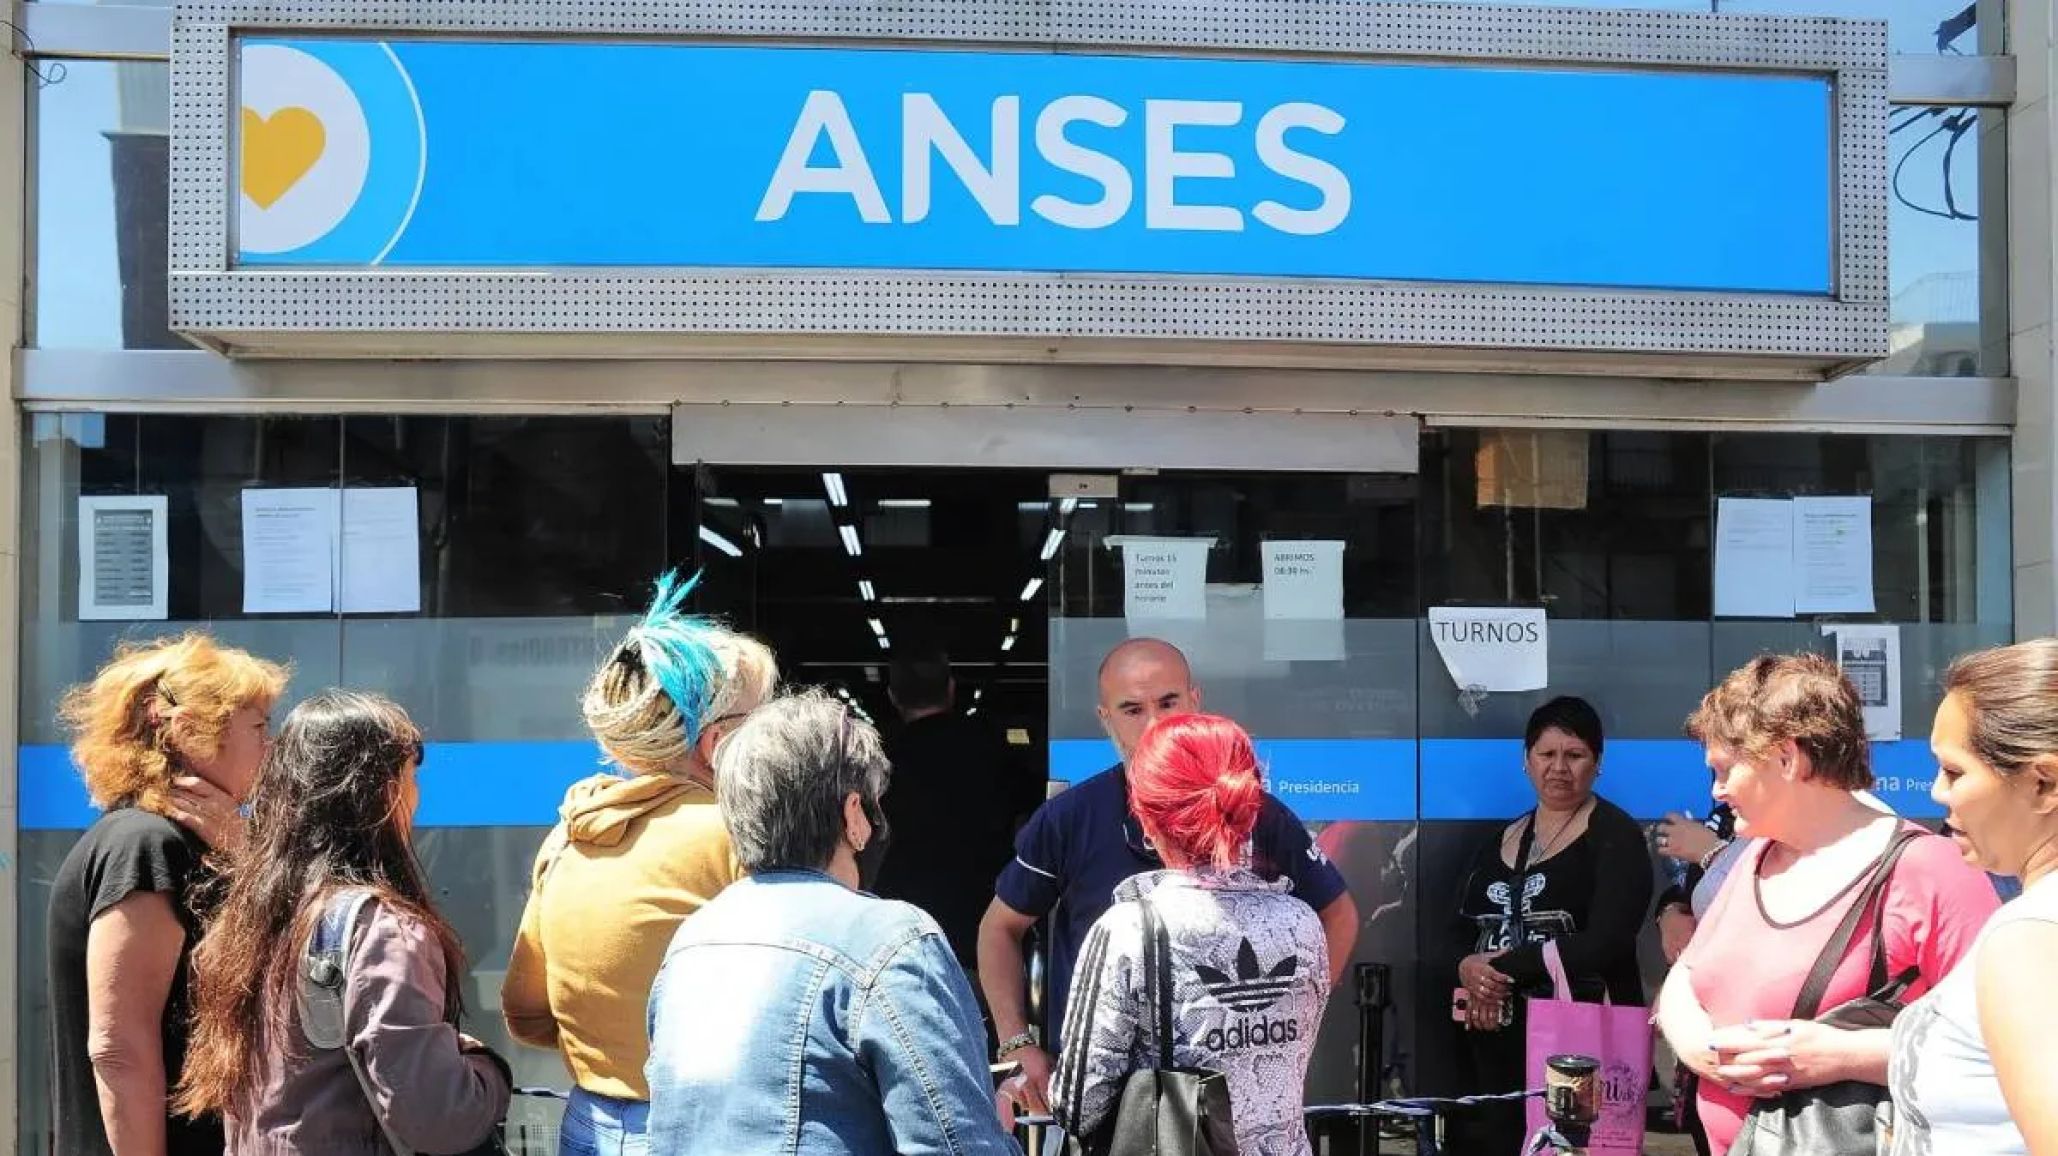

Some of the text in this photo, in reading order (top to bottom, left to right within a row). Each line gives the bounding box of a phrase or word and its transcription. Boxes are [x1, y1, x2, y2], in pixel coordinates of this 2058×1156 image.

[754, 90, 1351, 236] ANSES
[1274, 553, 1315, 562] ABRIMOS
[1434, 620, 1539, 643] TURNOS
[1279, 779, 1360, 793] Presidencia
[1207, 1015, 1298, 1051] adidas
